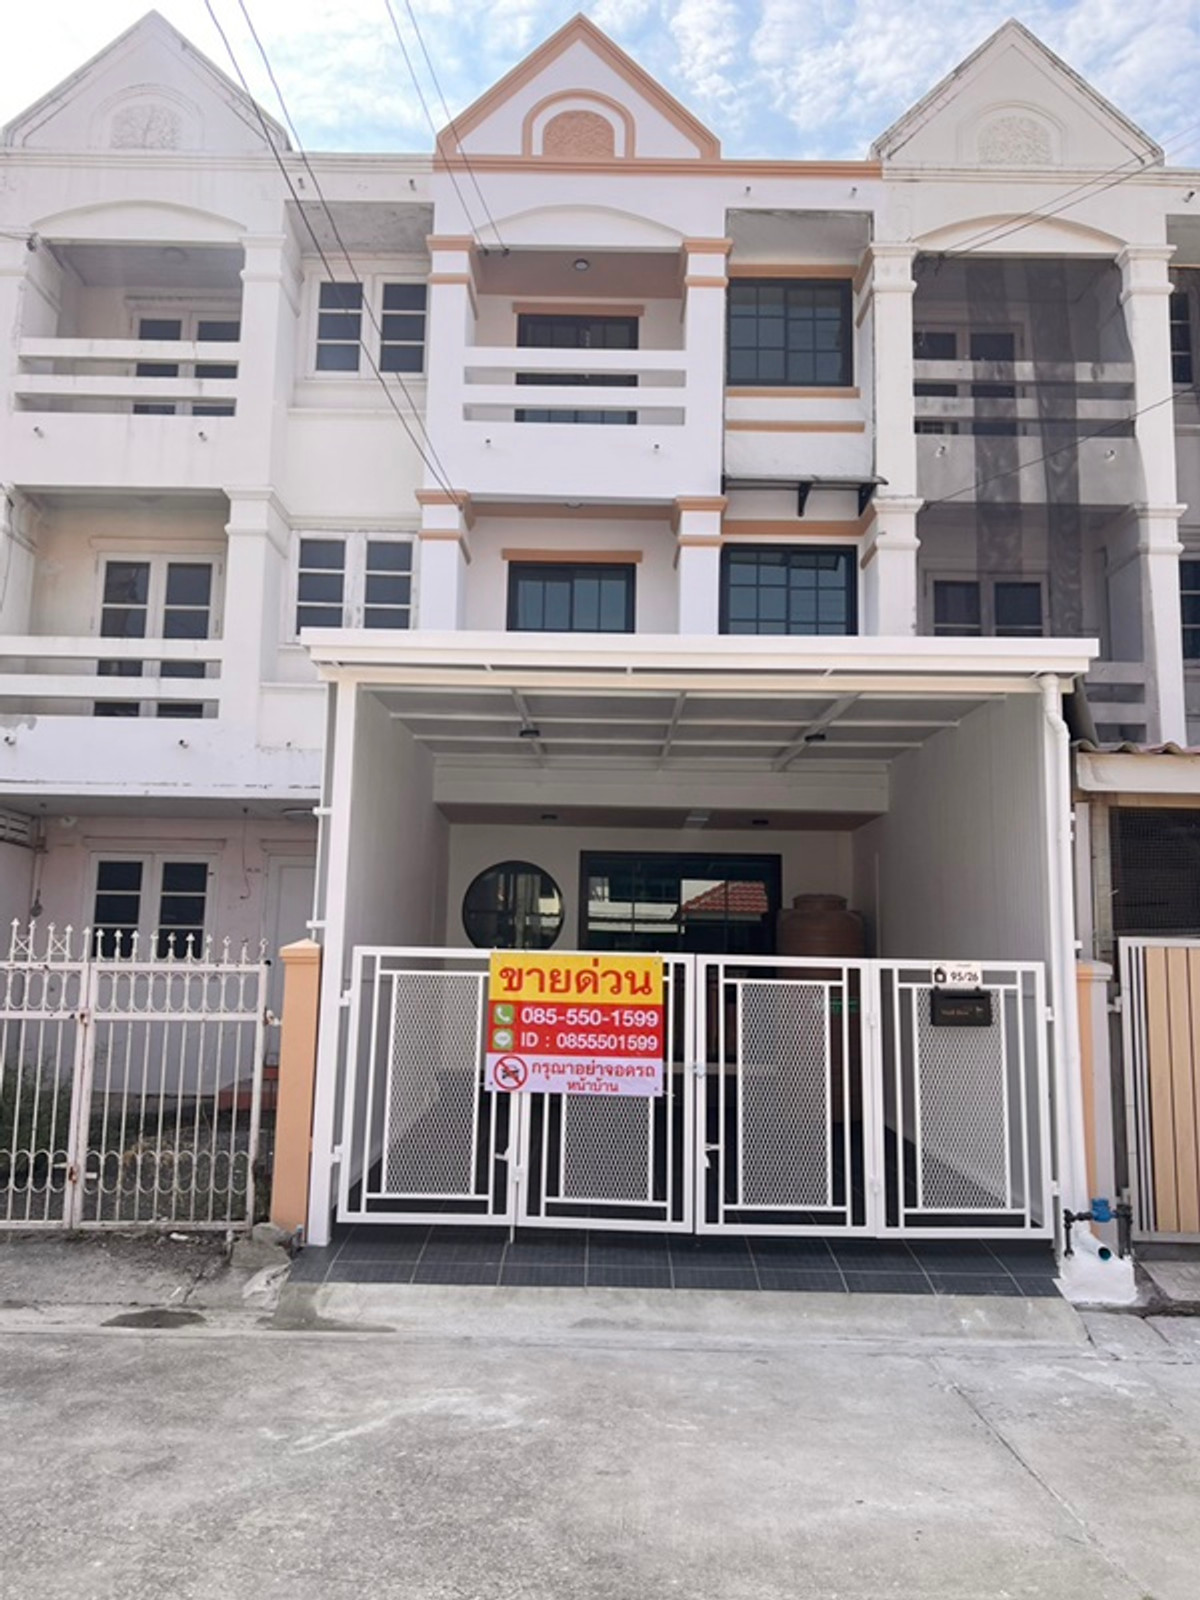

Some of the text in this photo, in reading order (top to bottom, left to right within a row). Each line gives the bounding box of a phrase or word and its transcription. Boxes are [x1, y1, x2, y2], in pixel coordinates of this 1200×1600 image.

[499, 958, 653, 995] ขายด่วน
[521, 1007, 658, 1027] 085-550-1599
[520, 1031, 538, 1048] ID
[556, 1033, 658, 1050] 0855501599
[532, 1060, 656, 1080] กรุณาอย่าจอดรถ
[567, 1077, 619, 1093] หน้าบ้าน
